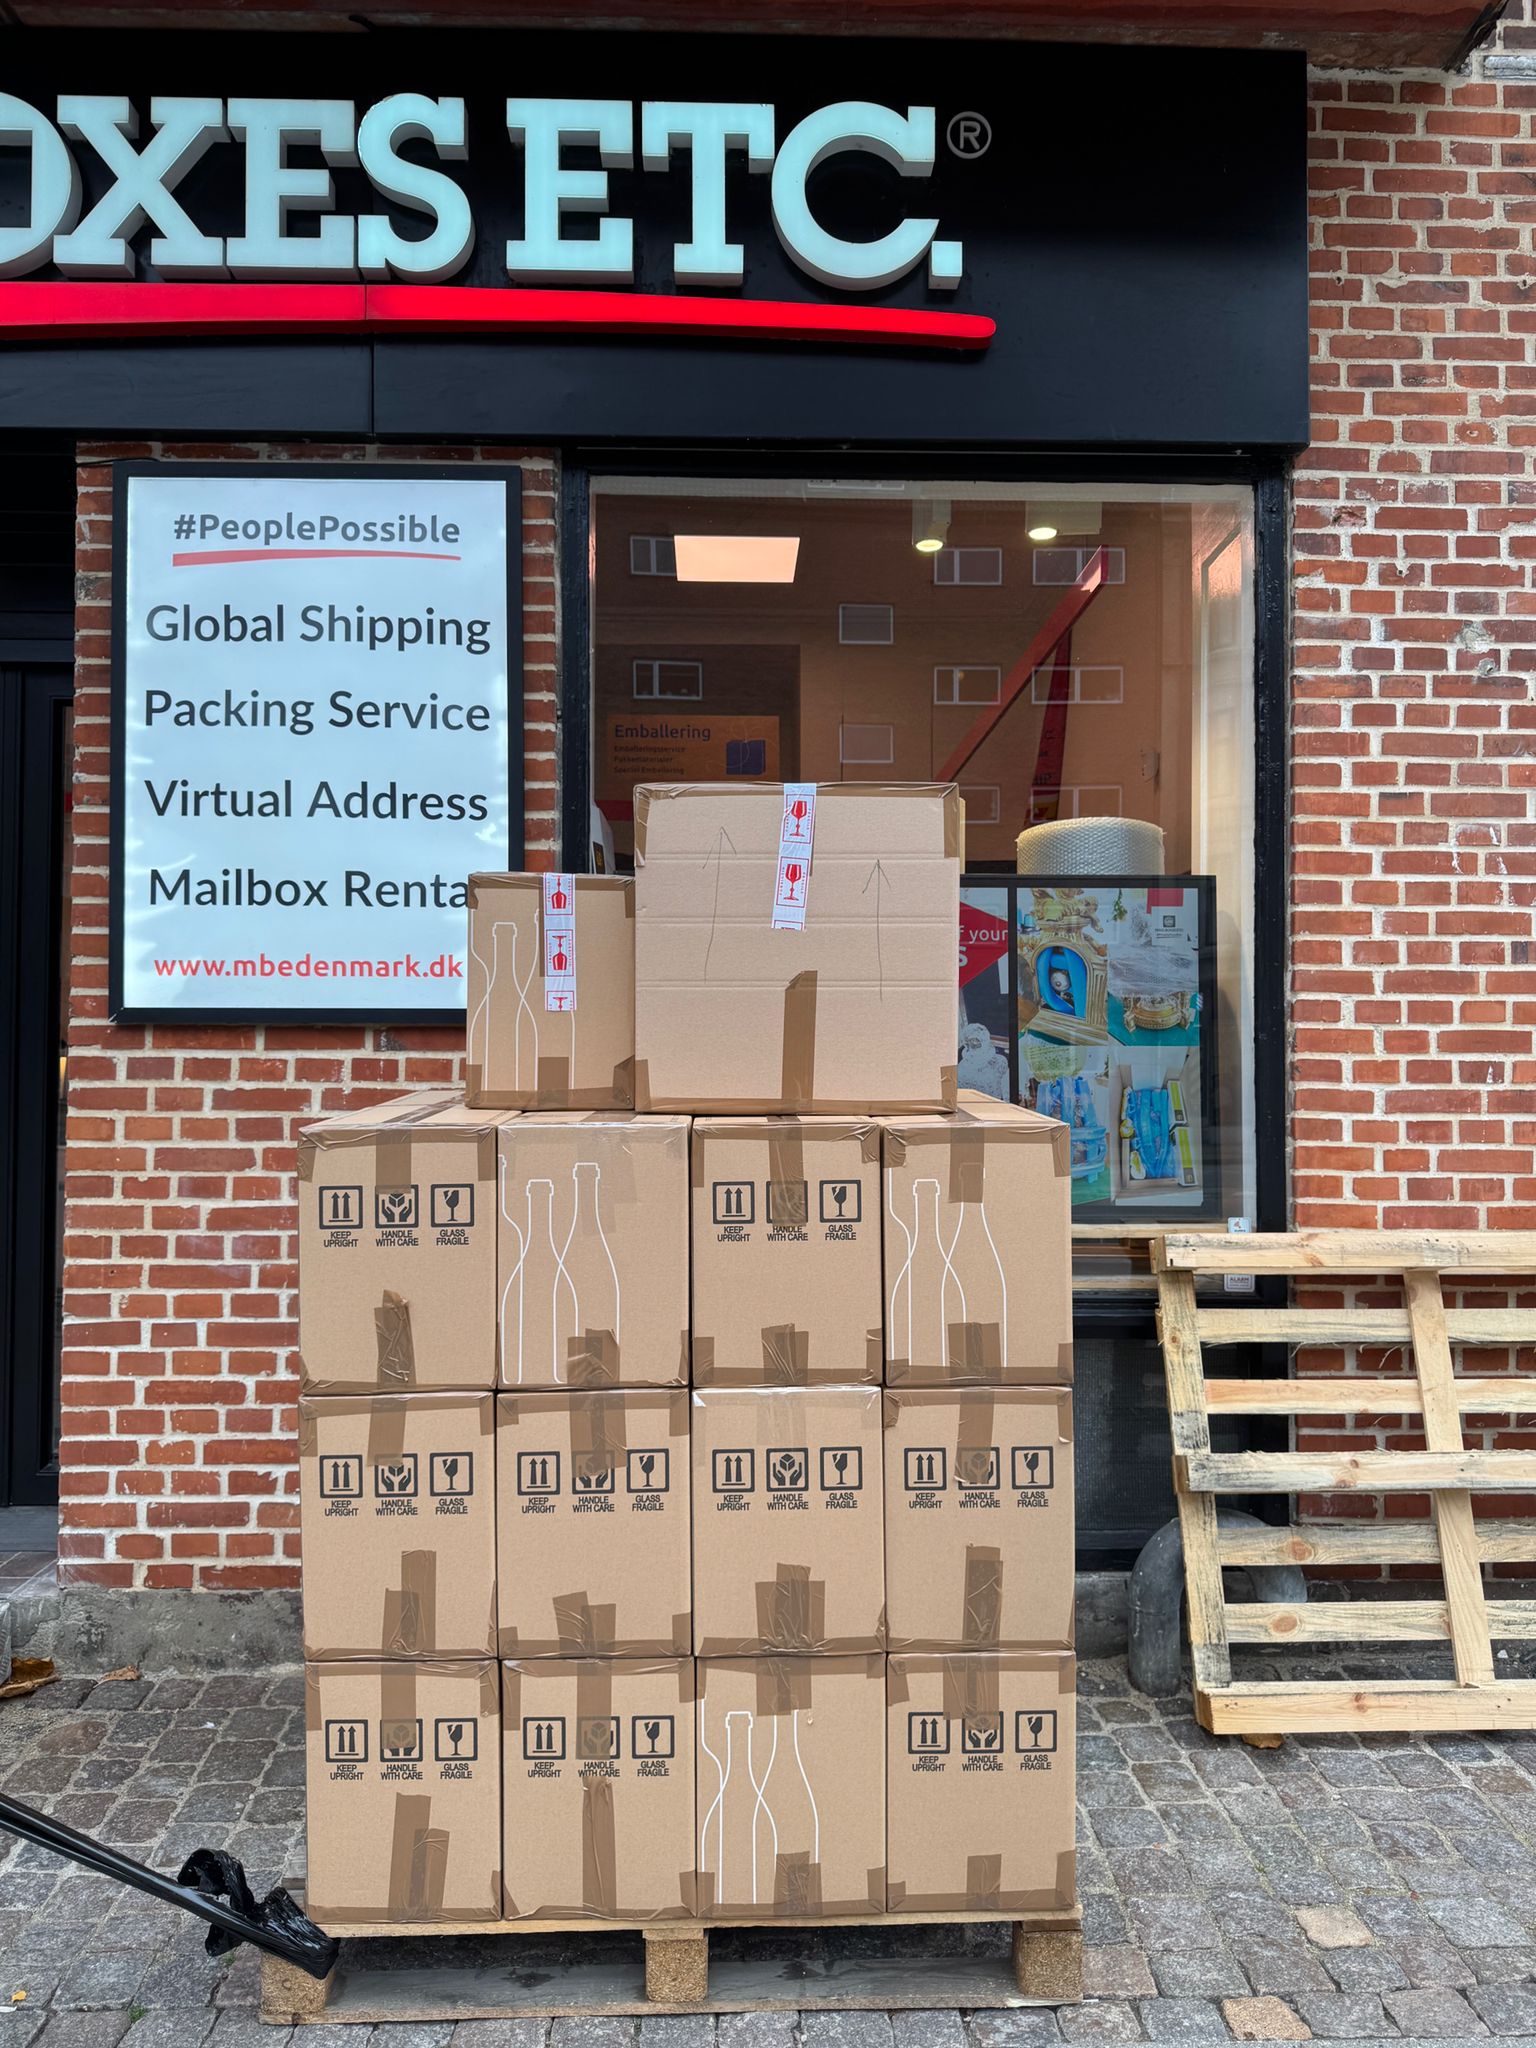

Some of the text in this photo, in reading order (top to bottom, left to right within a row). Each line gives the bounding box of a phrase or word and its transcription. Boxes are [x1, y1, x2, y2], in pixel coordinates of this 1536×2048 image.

[506, 98, 963, 286] ETC.
[173, 512, 461, 547] #PeoplePossible
[146, 604, 491, 655] Global Shipping
[145, 689, 491, 735] Packing Service
[614, 724, 711, 742] Emballering
[144, 779, 489, 821] Virtual Address
[149, 868, 468, 908] Mailbox Renta
[968, 928, 1008, 944] your
[154, 952, 464, 978] www.mbedenmark.dk
[723, 1226, 744, 1234] KEEP
[828, 1224, 852, 1232] GLASS
[382, 1230, 412, 1238] HANDLE
[440, 1229, 465, 1238] GLASS
[717, 1233, 750, 1242] UPRIGHT
[767, 1232, 808, 1241] WITH CARE
[825, 1232, 857, 1240] FRAGILE
[323, 1239, 358, 1248] UPRIGHT
[376, 1238, 419, 1247] WITH CARE
[436, 1237, 469, 1245] FRAGILE
[578, 1496, 608, 1504] HANDLE
[636, 1495, 660, 1503] GLASS
[723, 1495, 744, 1503] KEEP
[772, 1494, 802, 1502] HANDLE
[829, 1493, 854, 1501] GLASS
[916, 1493, 936, 1501] KEEP
[964, 1492, 994, 1500] HANDLE
[331, 1500, 352, 1508] KEEP
[381, 1499, 412, 1507] HANDLE
[439, 1498, 464, 1506] GLASS
[528, 1497, 549, 1505] KEEP
[825, 1500, 858, 1508] FRAGILE
[909, 1501, 942, 1509] UPRIGHT
[959, 1499, 1000, 1508] WITH CARE
[1017, 1499, 1048, 1507] FRAGILE
[522, 1505, 556, 1513] UPRIGHT
[573, 1503, 615, 1512] WITH CARE
[632, 1502, 664, 1511] FRAGILE
[717, 1502, 750, 1511] UPRIGHT
[767, 1501, 809, 1510] WITH CARE
[324, 1508, 358, 1516] UPRIGHT
[375, 1507, 418, 1516] WITH CARE
[435, 1506, 468, 1514] FRAGILE
[919, 1756, 939, 1764] KEEP
[1024, 1754, 1048, 1762] GLASS
[337, 1764, 357, 1772] KEEP
[386, 1764, 417, 1772] HANDLE
[443, 1763, 469, 1771] GLASS
[534, 1762, 555, 1770] KEEP
[641, 1761, 665, 1769] GLASS
[912, 1763, 946, 1772] UPRIGHT
[962, 1763, 1003, 1771] WITH CARE
[1020, 1762, 1052, 1770] FRAGILE
[330, 1772, 364, 1780] UPRIGHT
[381, 1771, 423, 1780] WITH CARE
[440, 1771, 472, 1779] FRAGILE
[528, 1769, 561, 1778] UPRIGHT
[578, 1768, 620, 1777] WITH CARE
[637, 1768, 669, 1777] FRAGILE
